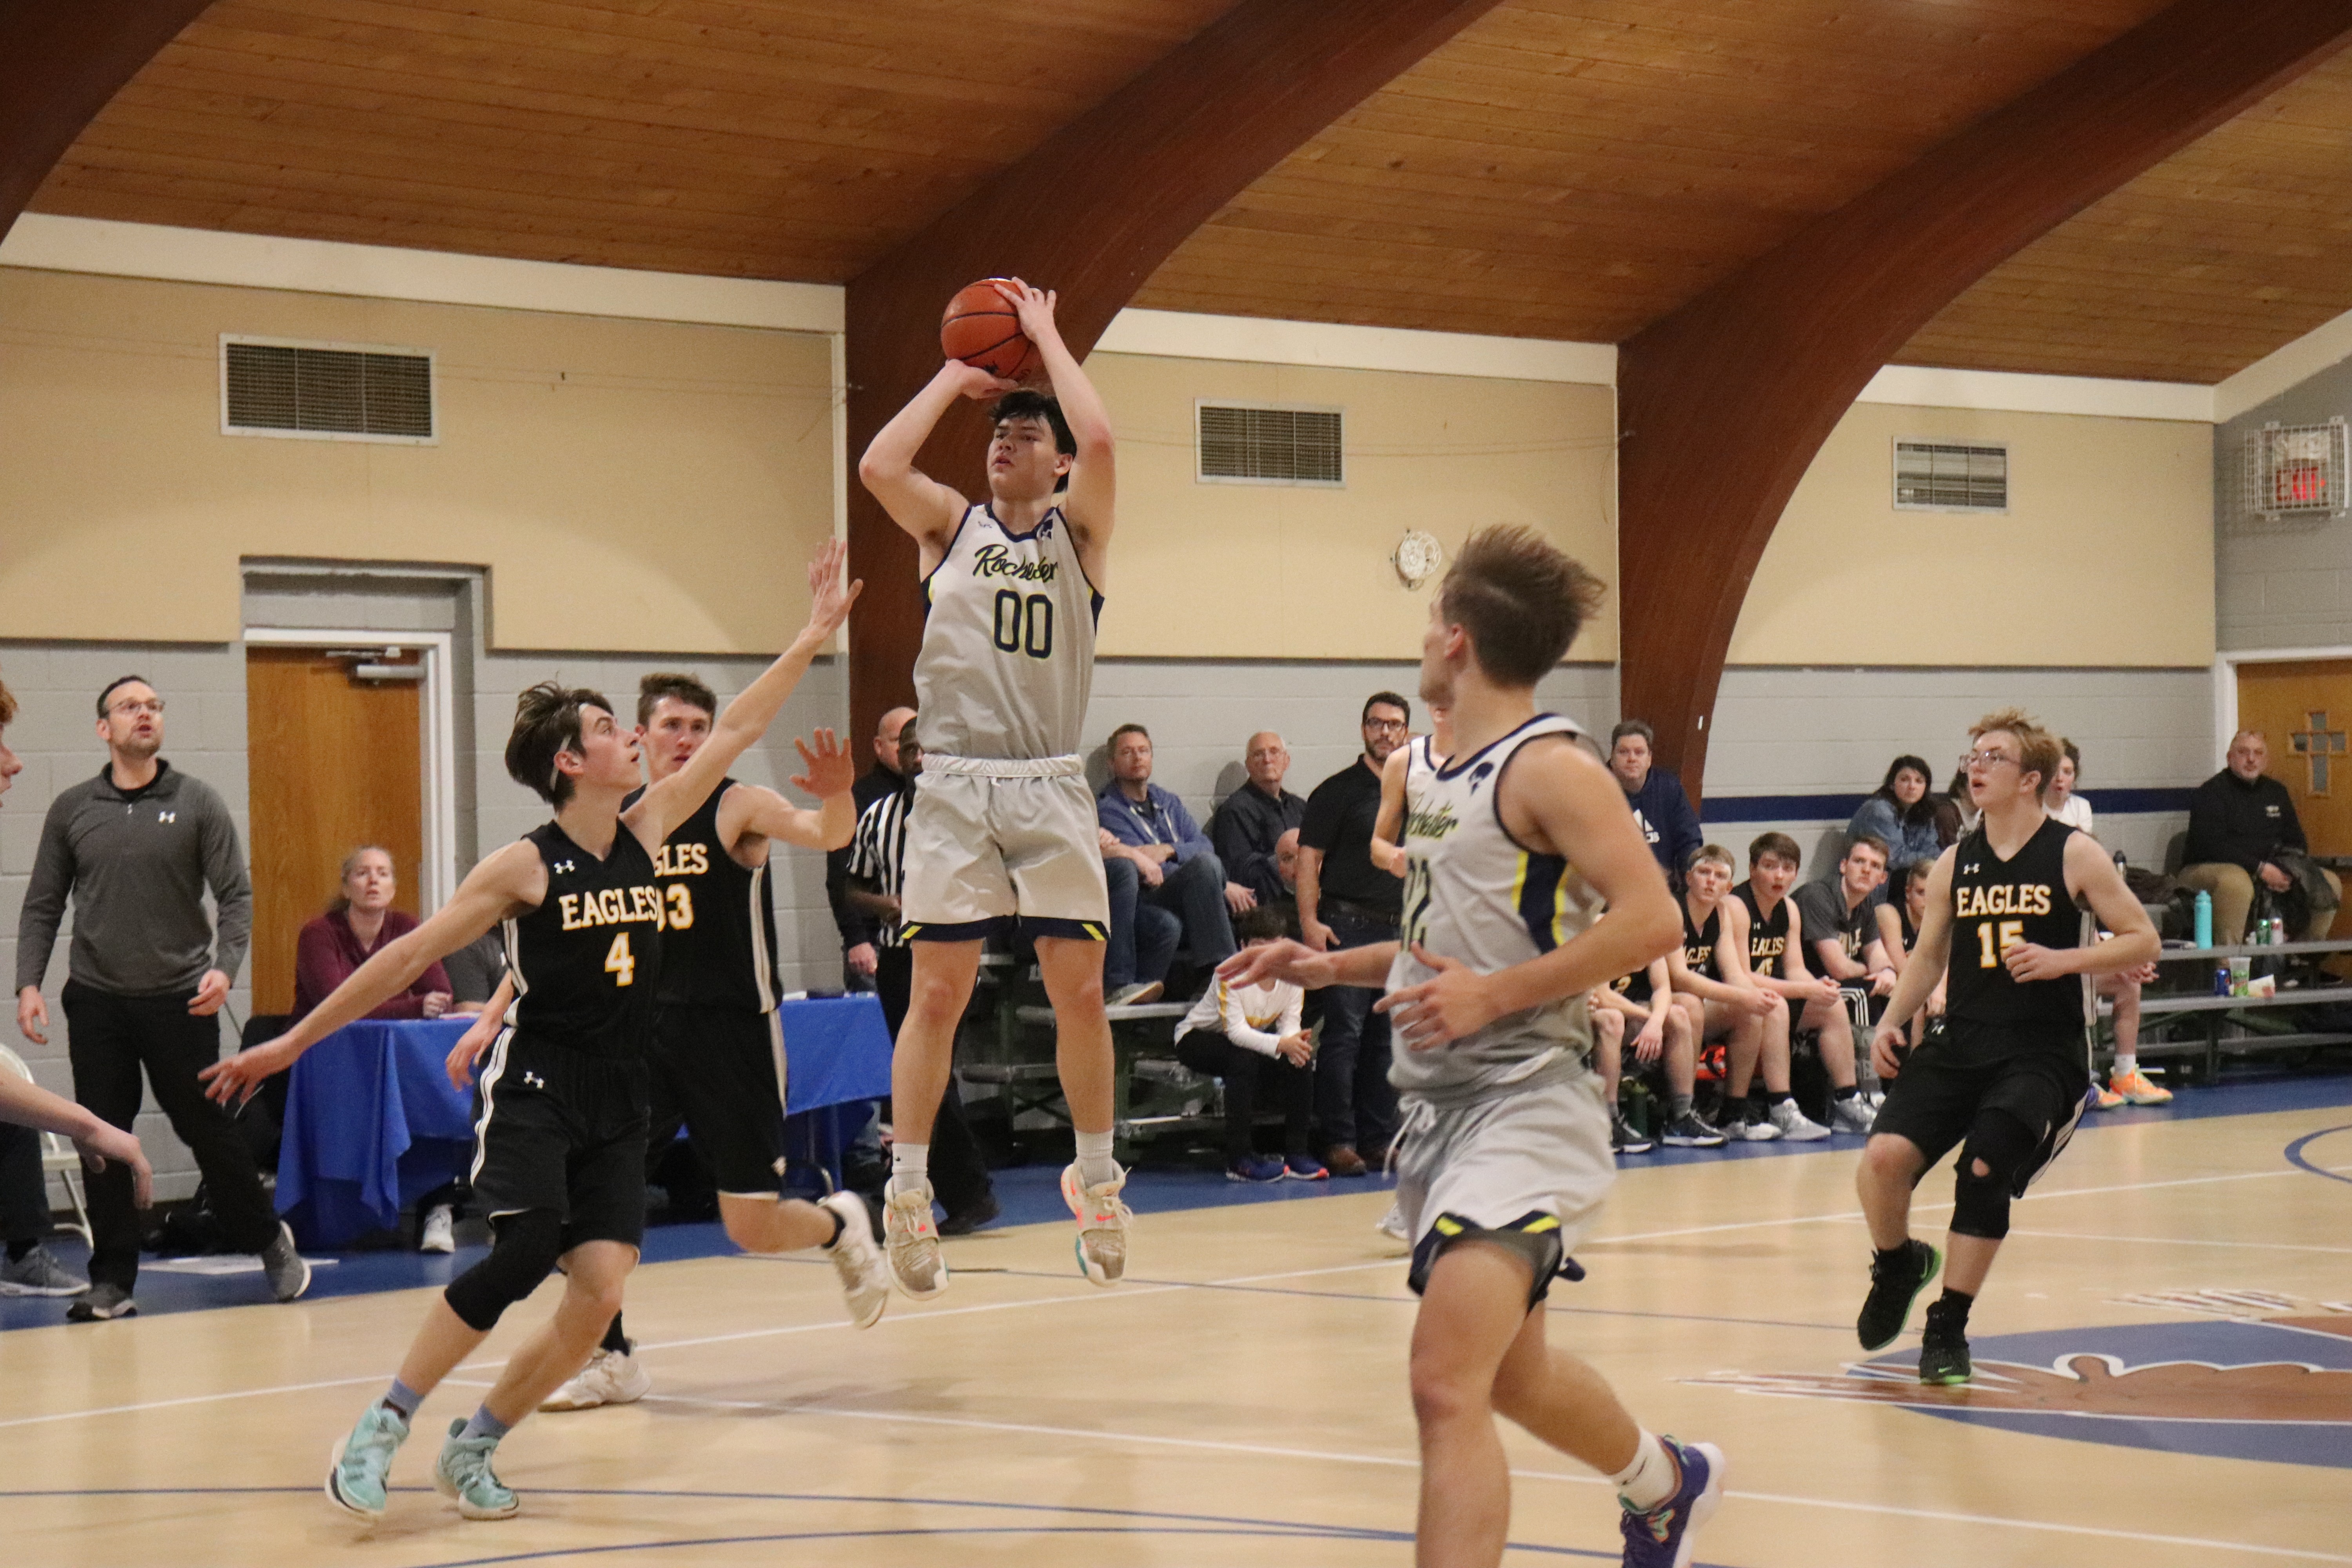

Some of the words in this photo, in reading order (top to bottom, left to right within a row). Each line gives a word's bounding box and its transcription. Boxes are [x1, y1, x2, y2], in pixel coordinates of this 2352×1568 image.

[993, 588, 1053, 659] 00
[558, 885, 659, 931] EAGLES
[1956, 883, 2052, 918] EAGLES
[604, 931, 635, 987] 4
